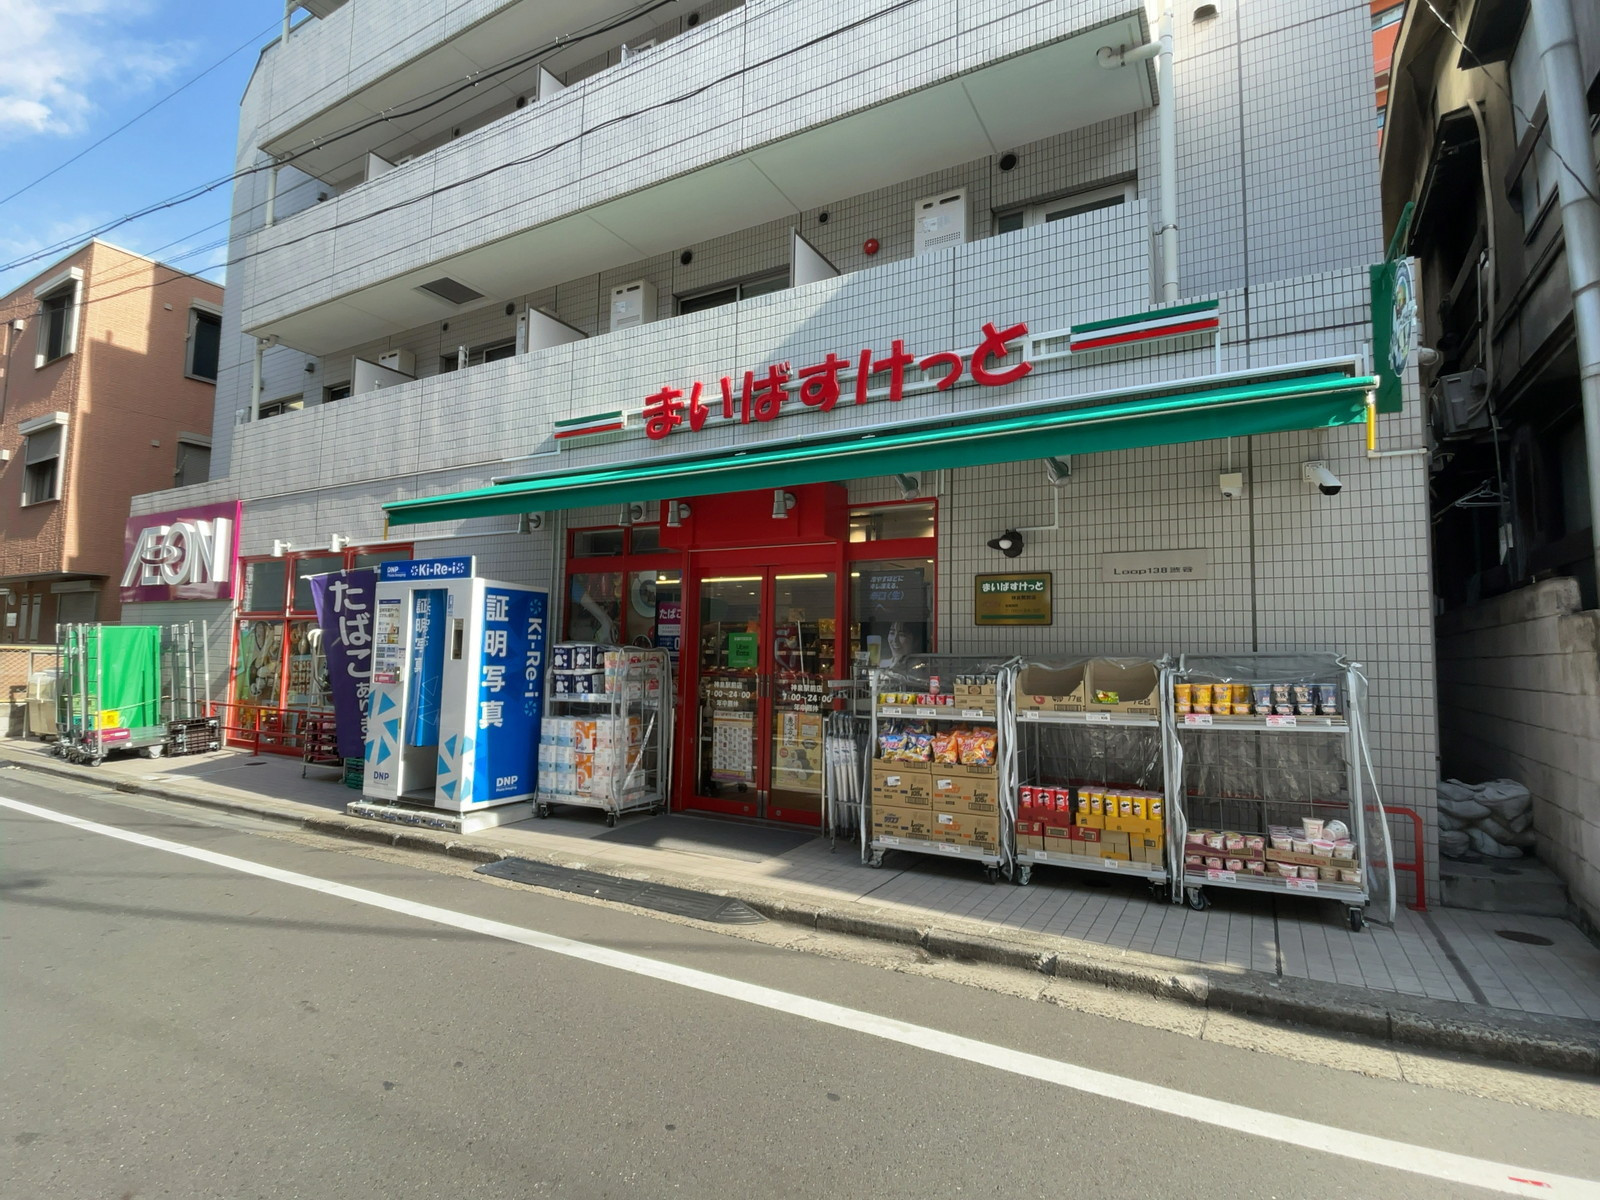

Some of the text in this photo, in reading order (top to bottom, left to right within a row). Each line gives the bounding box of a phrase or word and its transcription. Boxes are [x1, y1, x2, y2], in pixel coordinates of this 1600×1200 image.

[642, 322, 1033, 440] まいばすけっと
[419, 562, 456, 576] Ki-Re-i
[982, 581, 1044, 592] まいばすけっと
[329, 580, 372, 678] たばこ
[479, 595, 509, 730] 証明写真
[525, 617, 542, 698] Ki-Re-i
[373, 771, 389, 780] DNP
[496, 775, 518, 786] DNP
